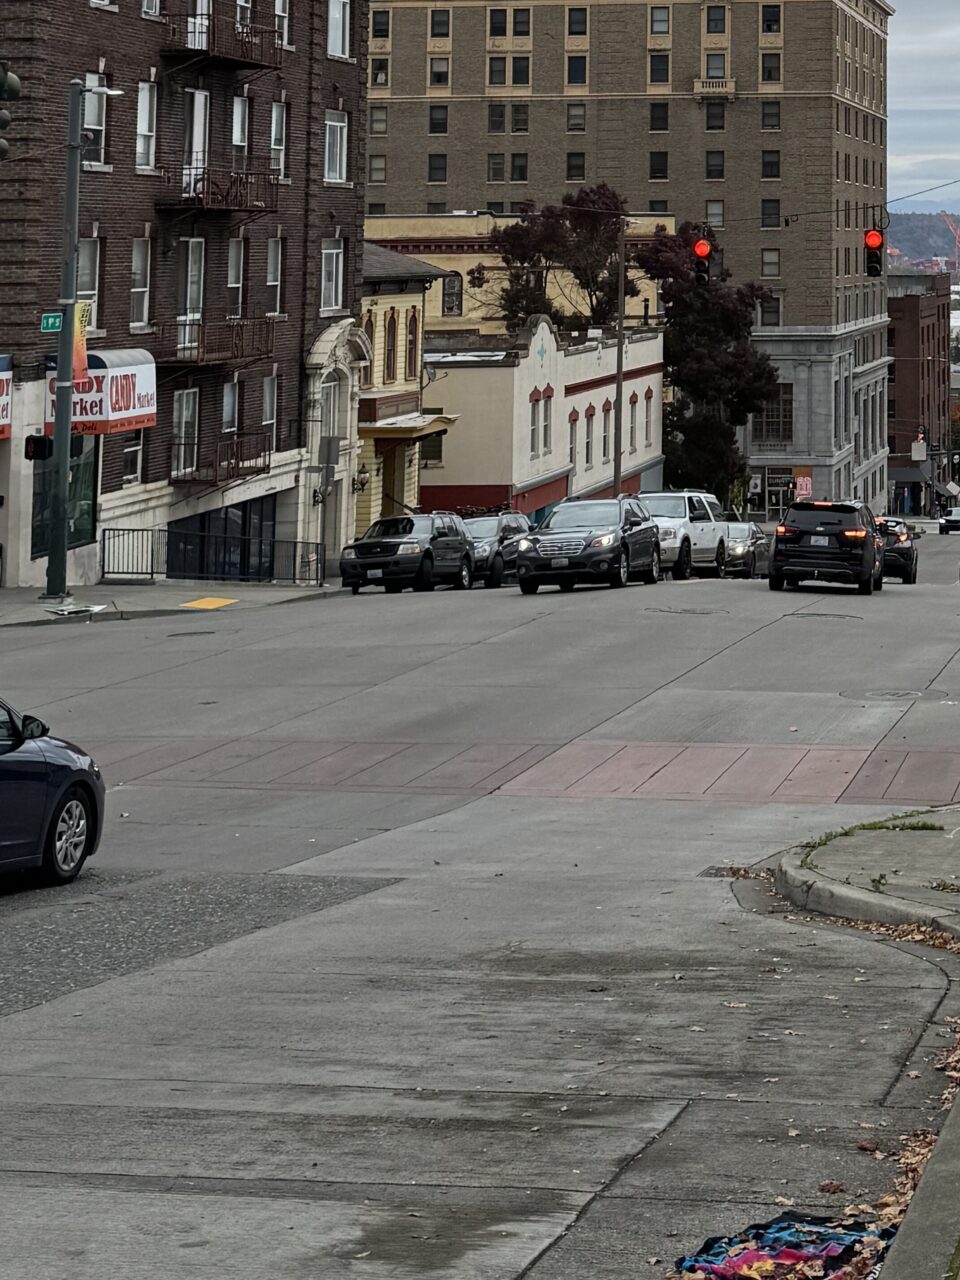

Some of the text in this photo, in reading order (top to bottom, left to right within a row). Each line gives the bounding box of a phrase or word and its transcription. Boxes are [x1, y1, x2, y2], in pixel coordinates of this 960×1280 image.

[49, 375, 106, 395] CDY
[110, 373, 155, 413] CANDY Market
[51, 397, 104, 417] rket
